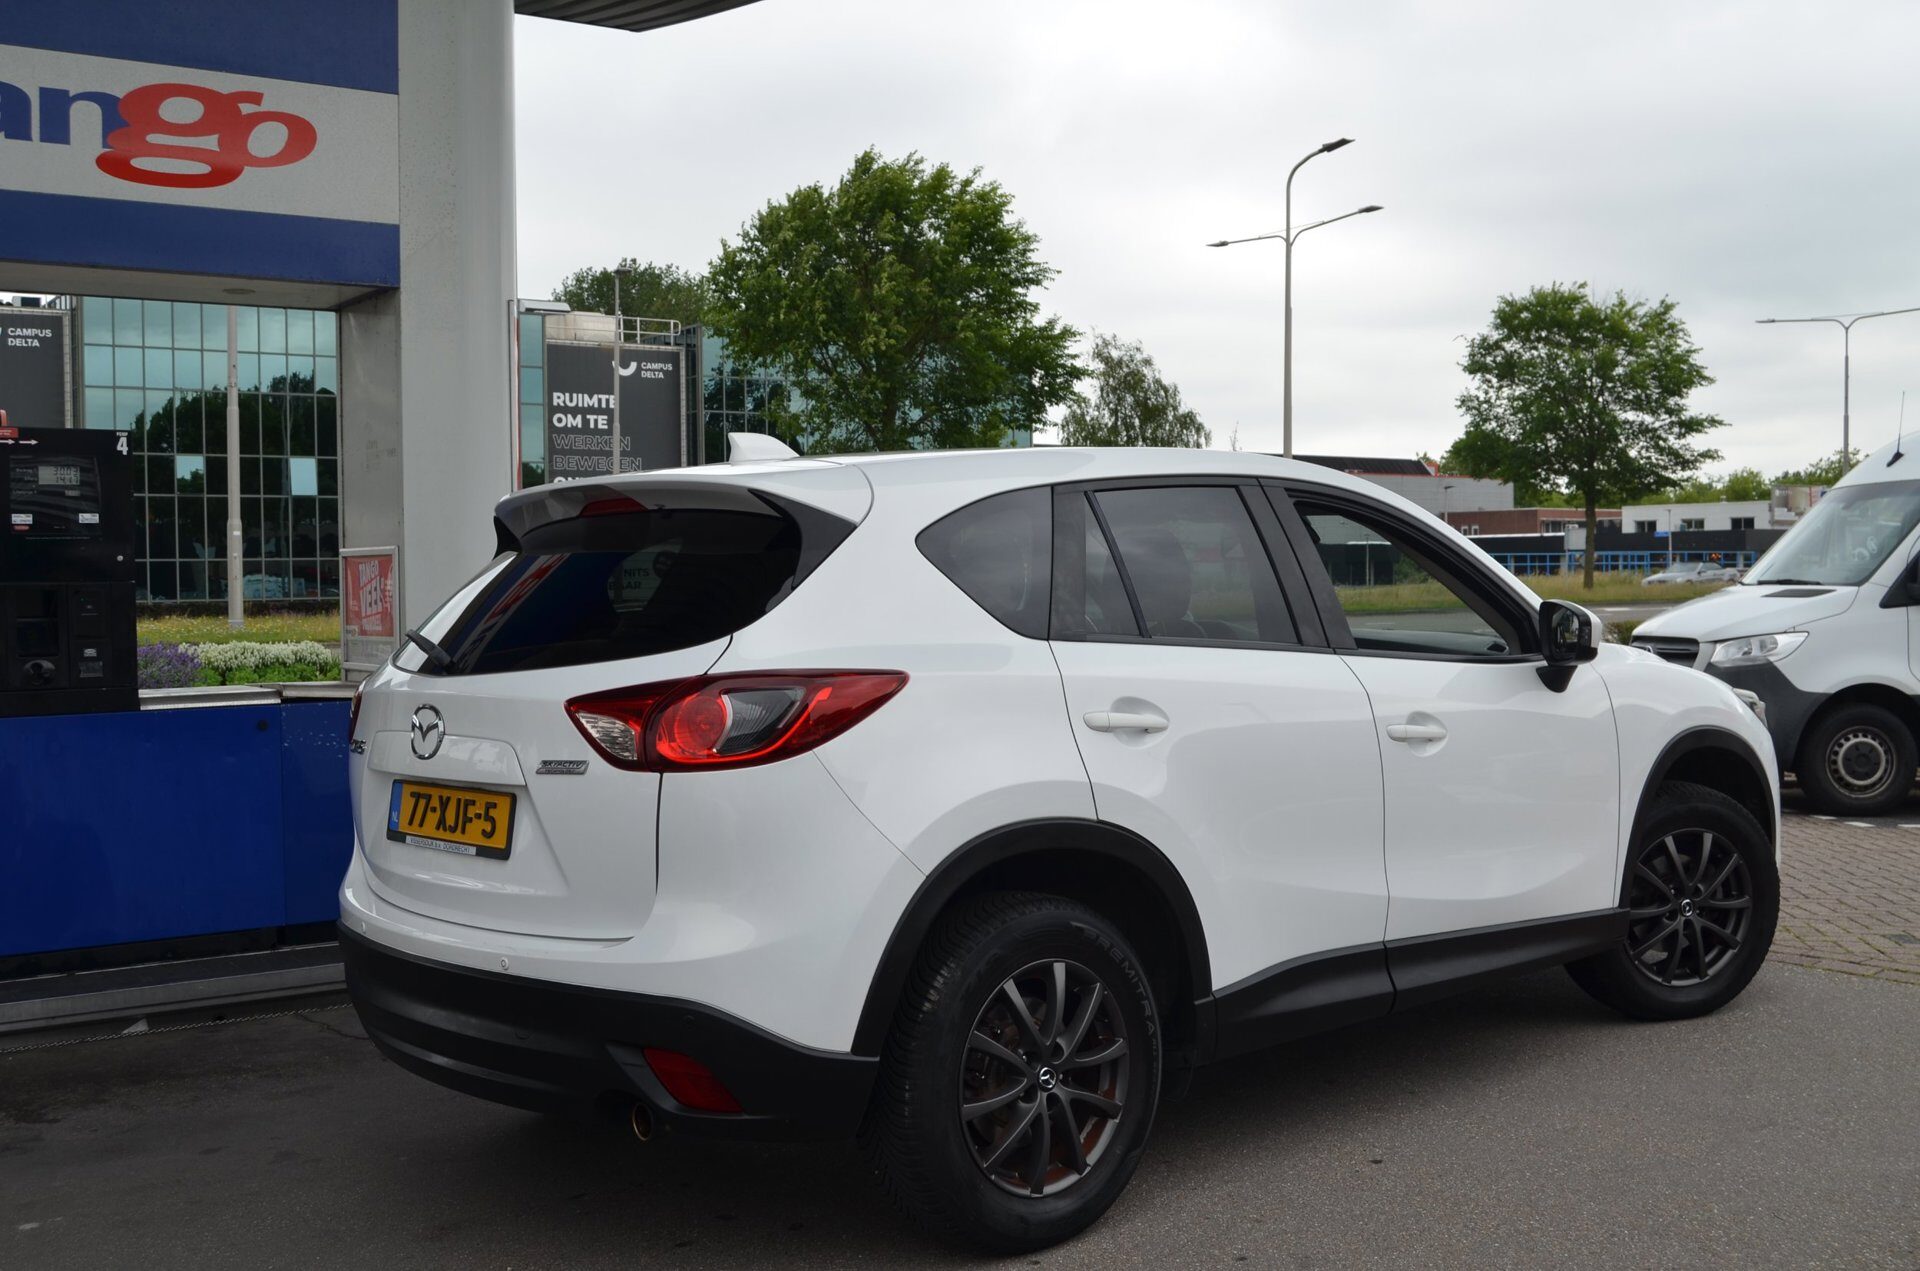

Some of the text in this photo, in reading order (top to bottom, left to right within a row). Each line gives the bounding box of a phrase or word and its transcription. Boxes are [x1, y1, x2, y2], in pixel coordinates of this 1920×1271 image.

[8, 327, 52, 337] CAMPUS
[8, 338, 40, 347] DELTA
[641, 362, 673, 371] CAMPUS
[641, 370, 664, 379] DELTA
[552, 413, 609, 430] OM TE
[116, 436, 129, 455] 4
[408, 791, 498, 840] 77-XJF-5
